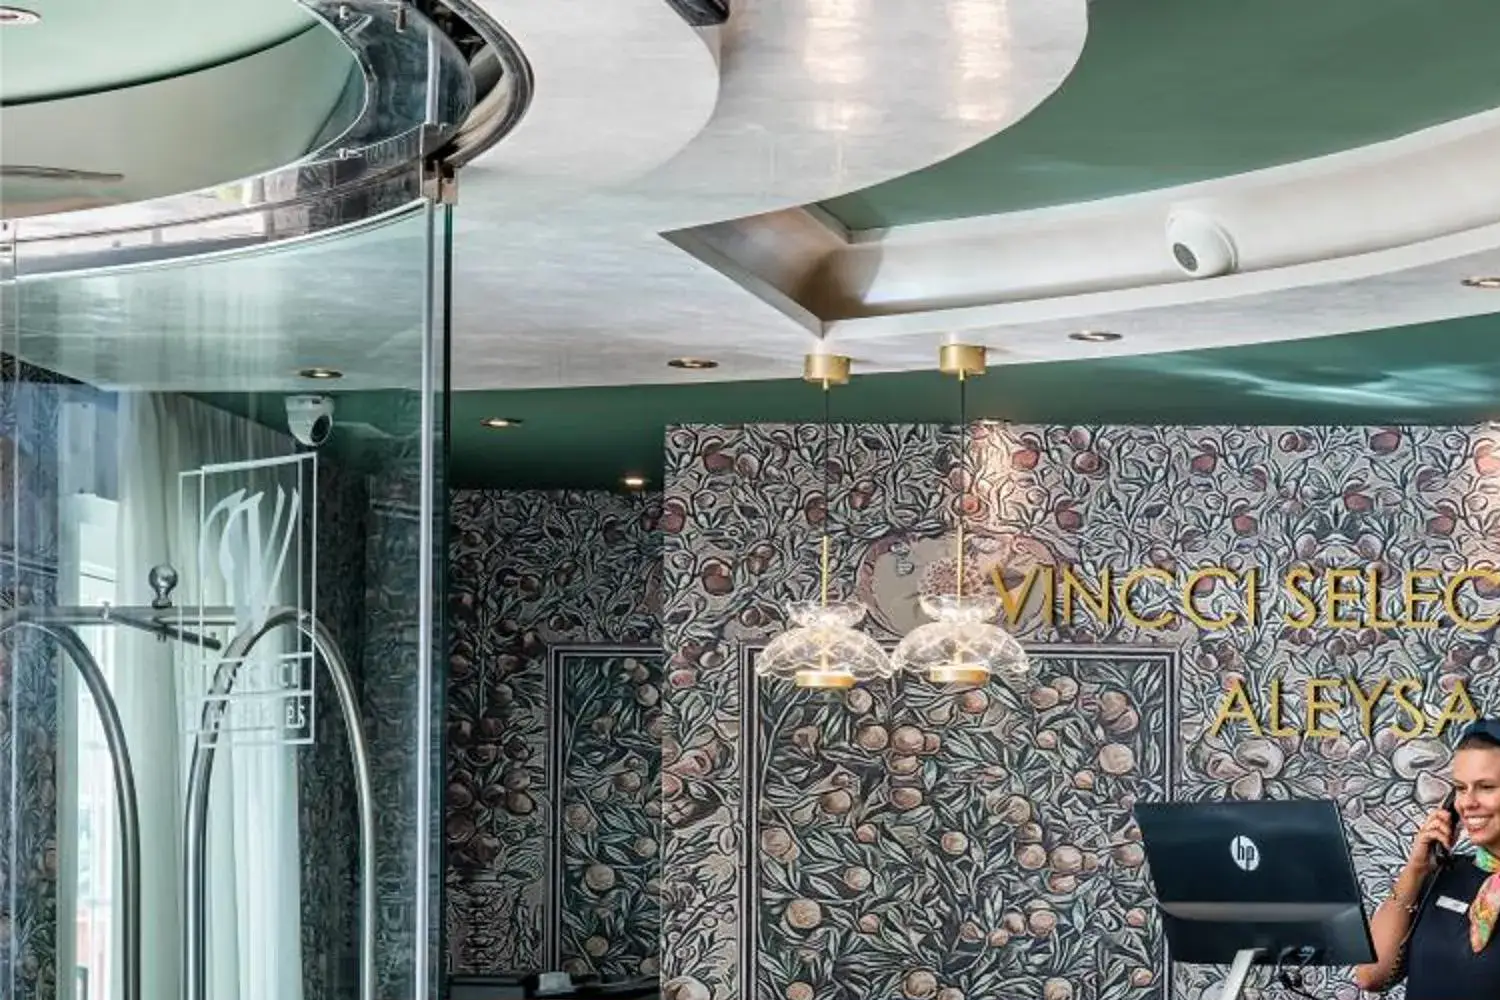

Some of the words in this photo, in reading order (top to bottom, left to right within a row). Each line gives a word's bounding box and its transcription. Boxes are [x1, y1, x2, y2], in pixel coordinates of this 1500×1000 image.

[992, 562, 1257, 630] VINCCI
[1211, 678, 1479, 738] ALEYSA
[1236, 834, 1257, 871] hp
